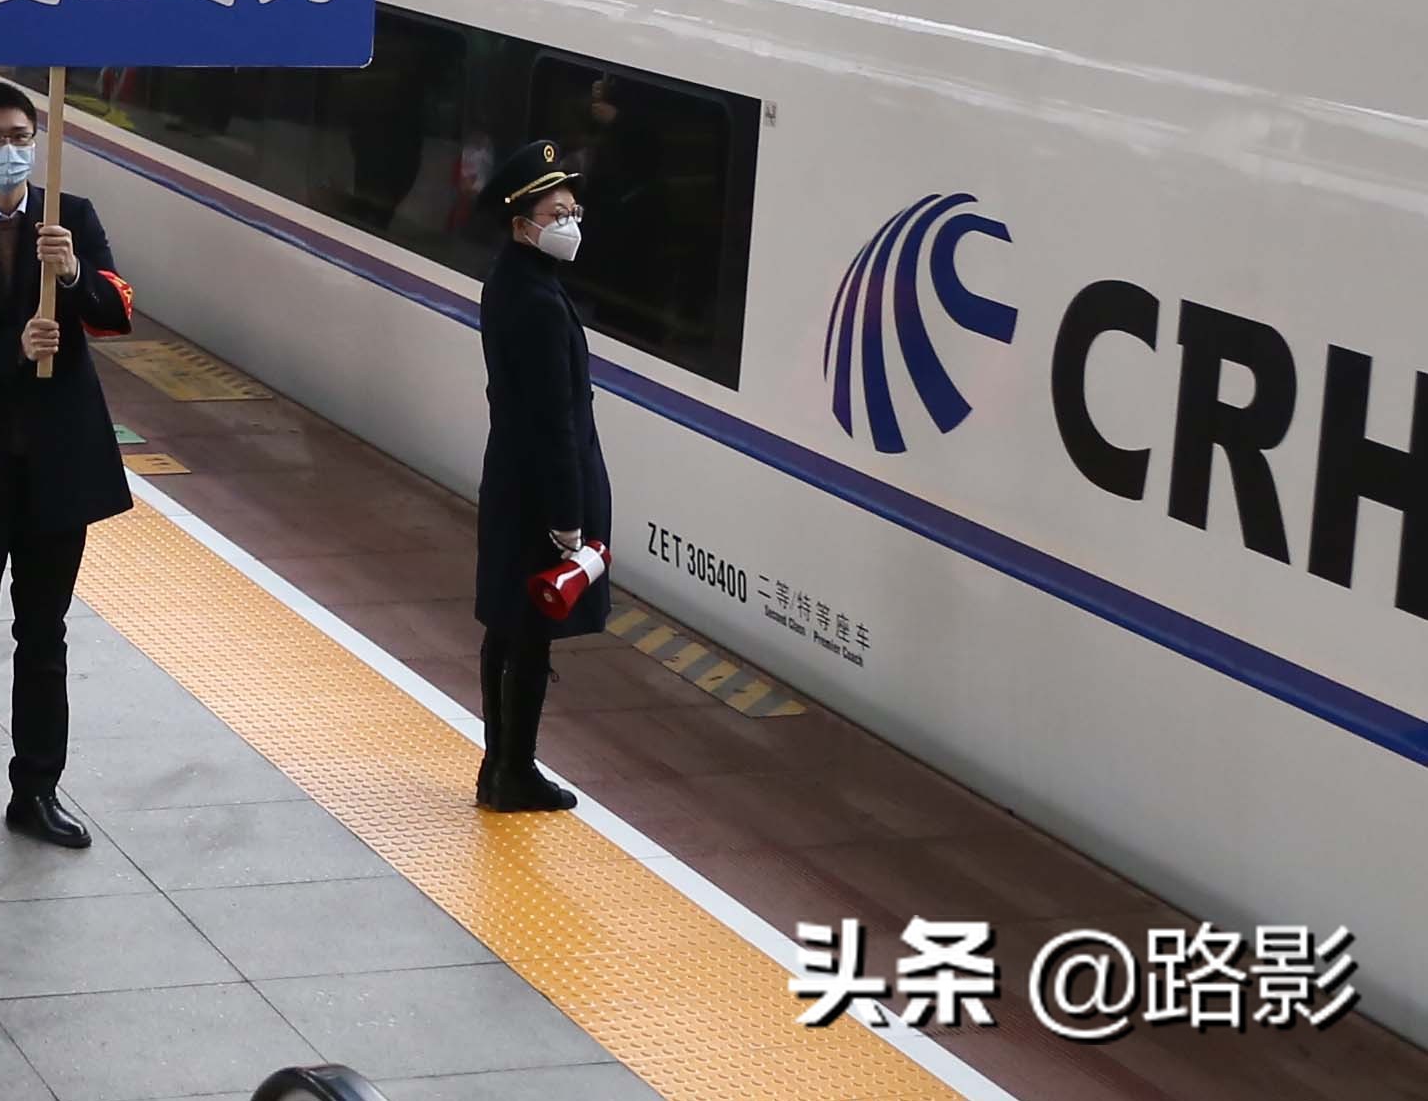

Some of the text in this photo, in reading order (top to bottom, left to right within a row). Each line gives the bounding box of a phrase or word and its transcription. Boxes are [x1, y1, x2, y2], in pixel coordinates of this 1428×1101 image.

[1051, 279, 1428, 622] CRH
[647, 521, 748, 604] ZET 305400
[757, 573, 871, 651] 二等/特等座车
